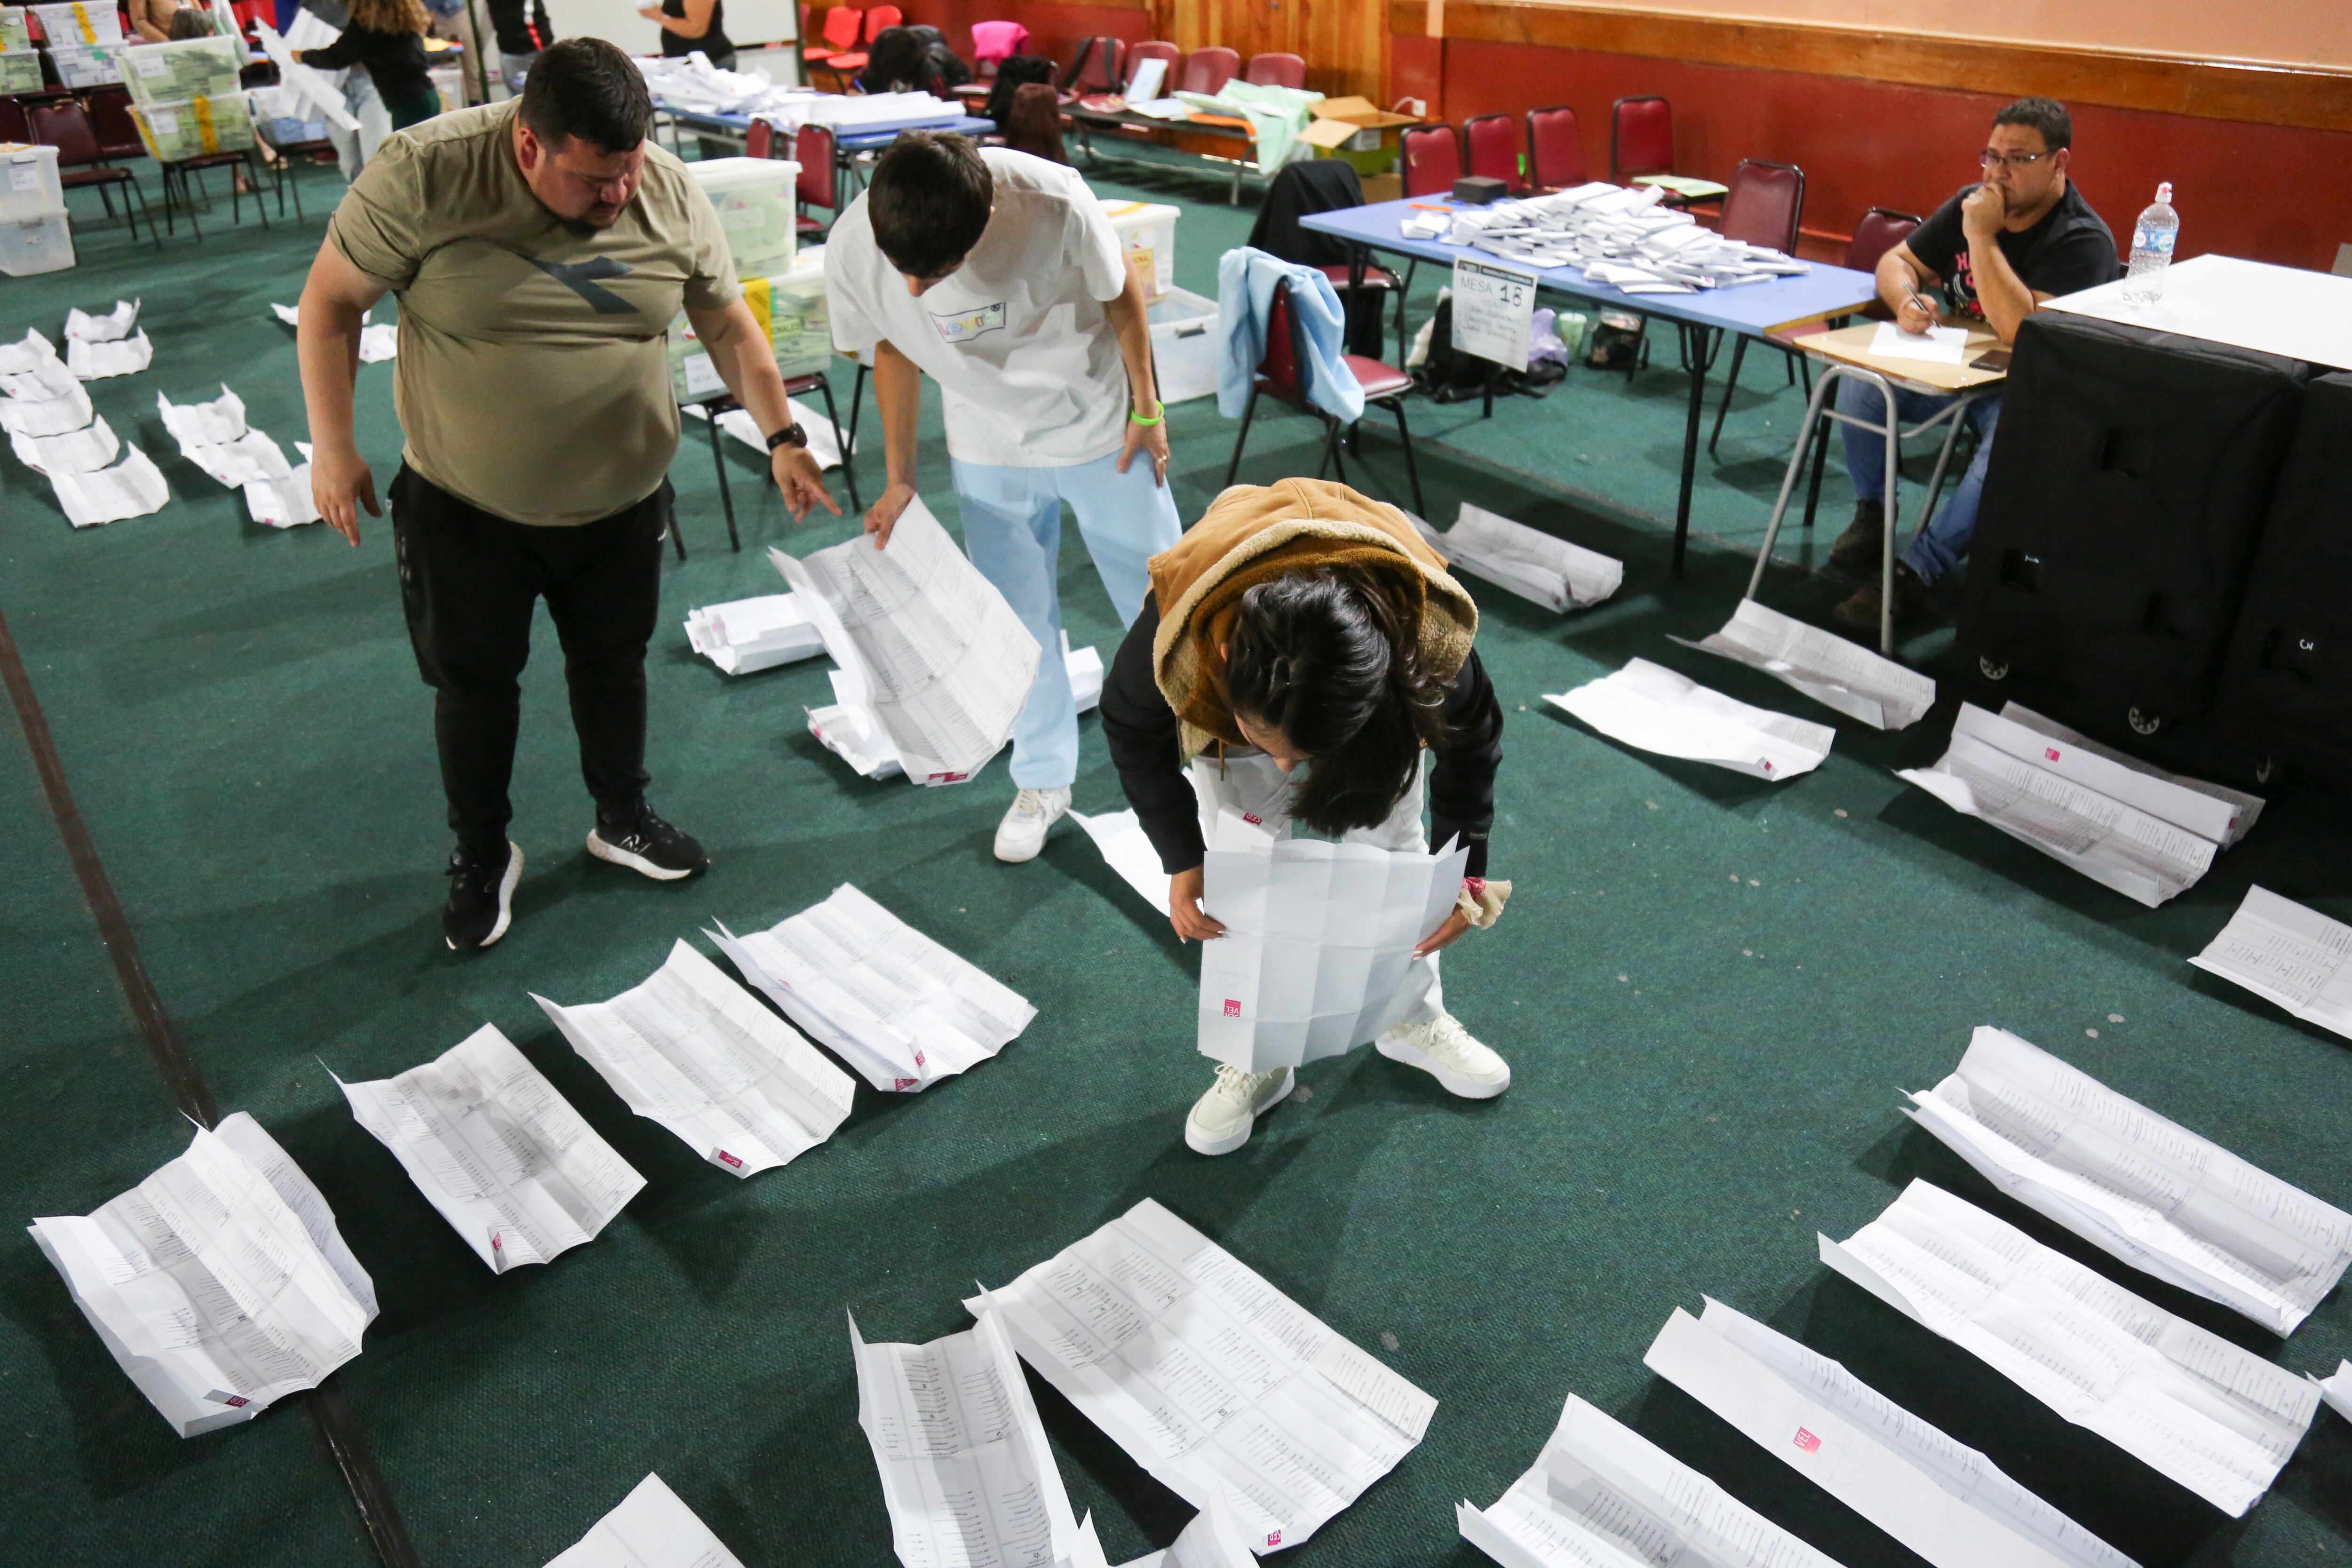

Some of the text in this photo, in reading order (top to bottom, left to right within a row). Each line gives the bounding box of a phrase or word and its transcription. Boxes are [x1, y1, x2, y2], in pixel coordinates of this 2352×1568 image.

[1461, 277, 1523, 307] MESA 18
[1246, 813, 1260, 822] SER
[1225, 1006, 1239, 1014] VEL
[1794, 1431, 1811, 1446] VEL
